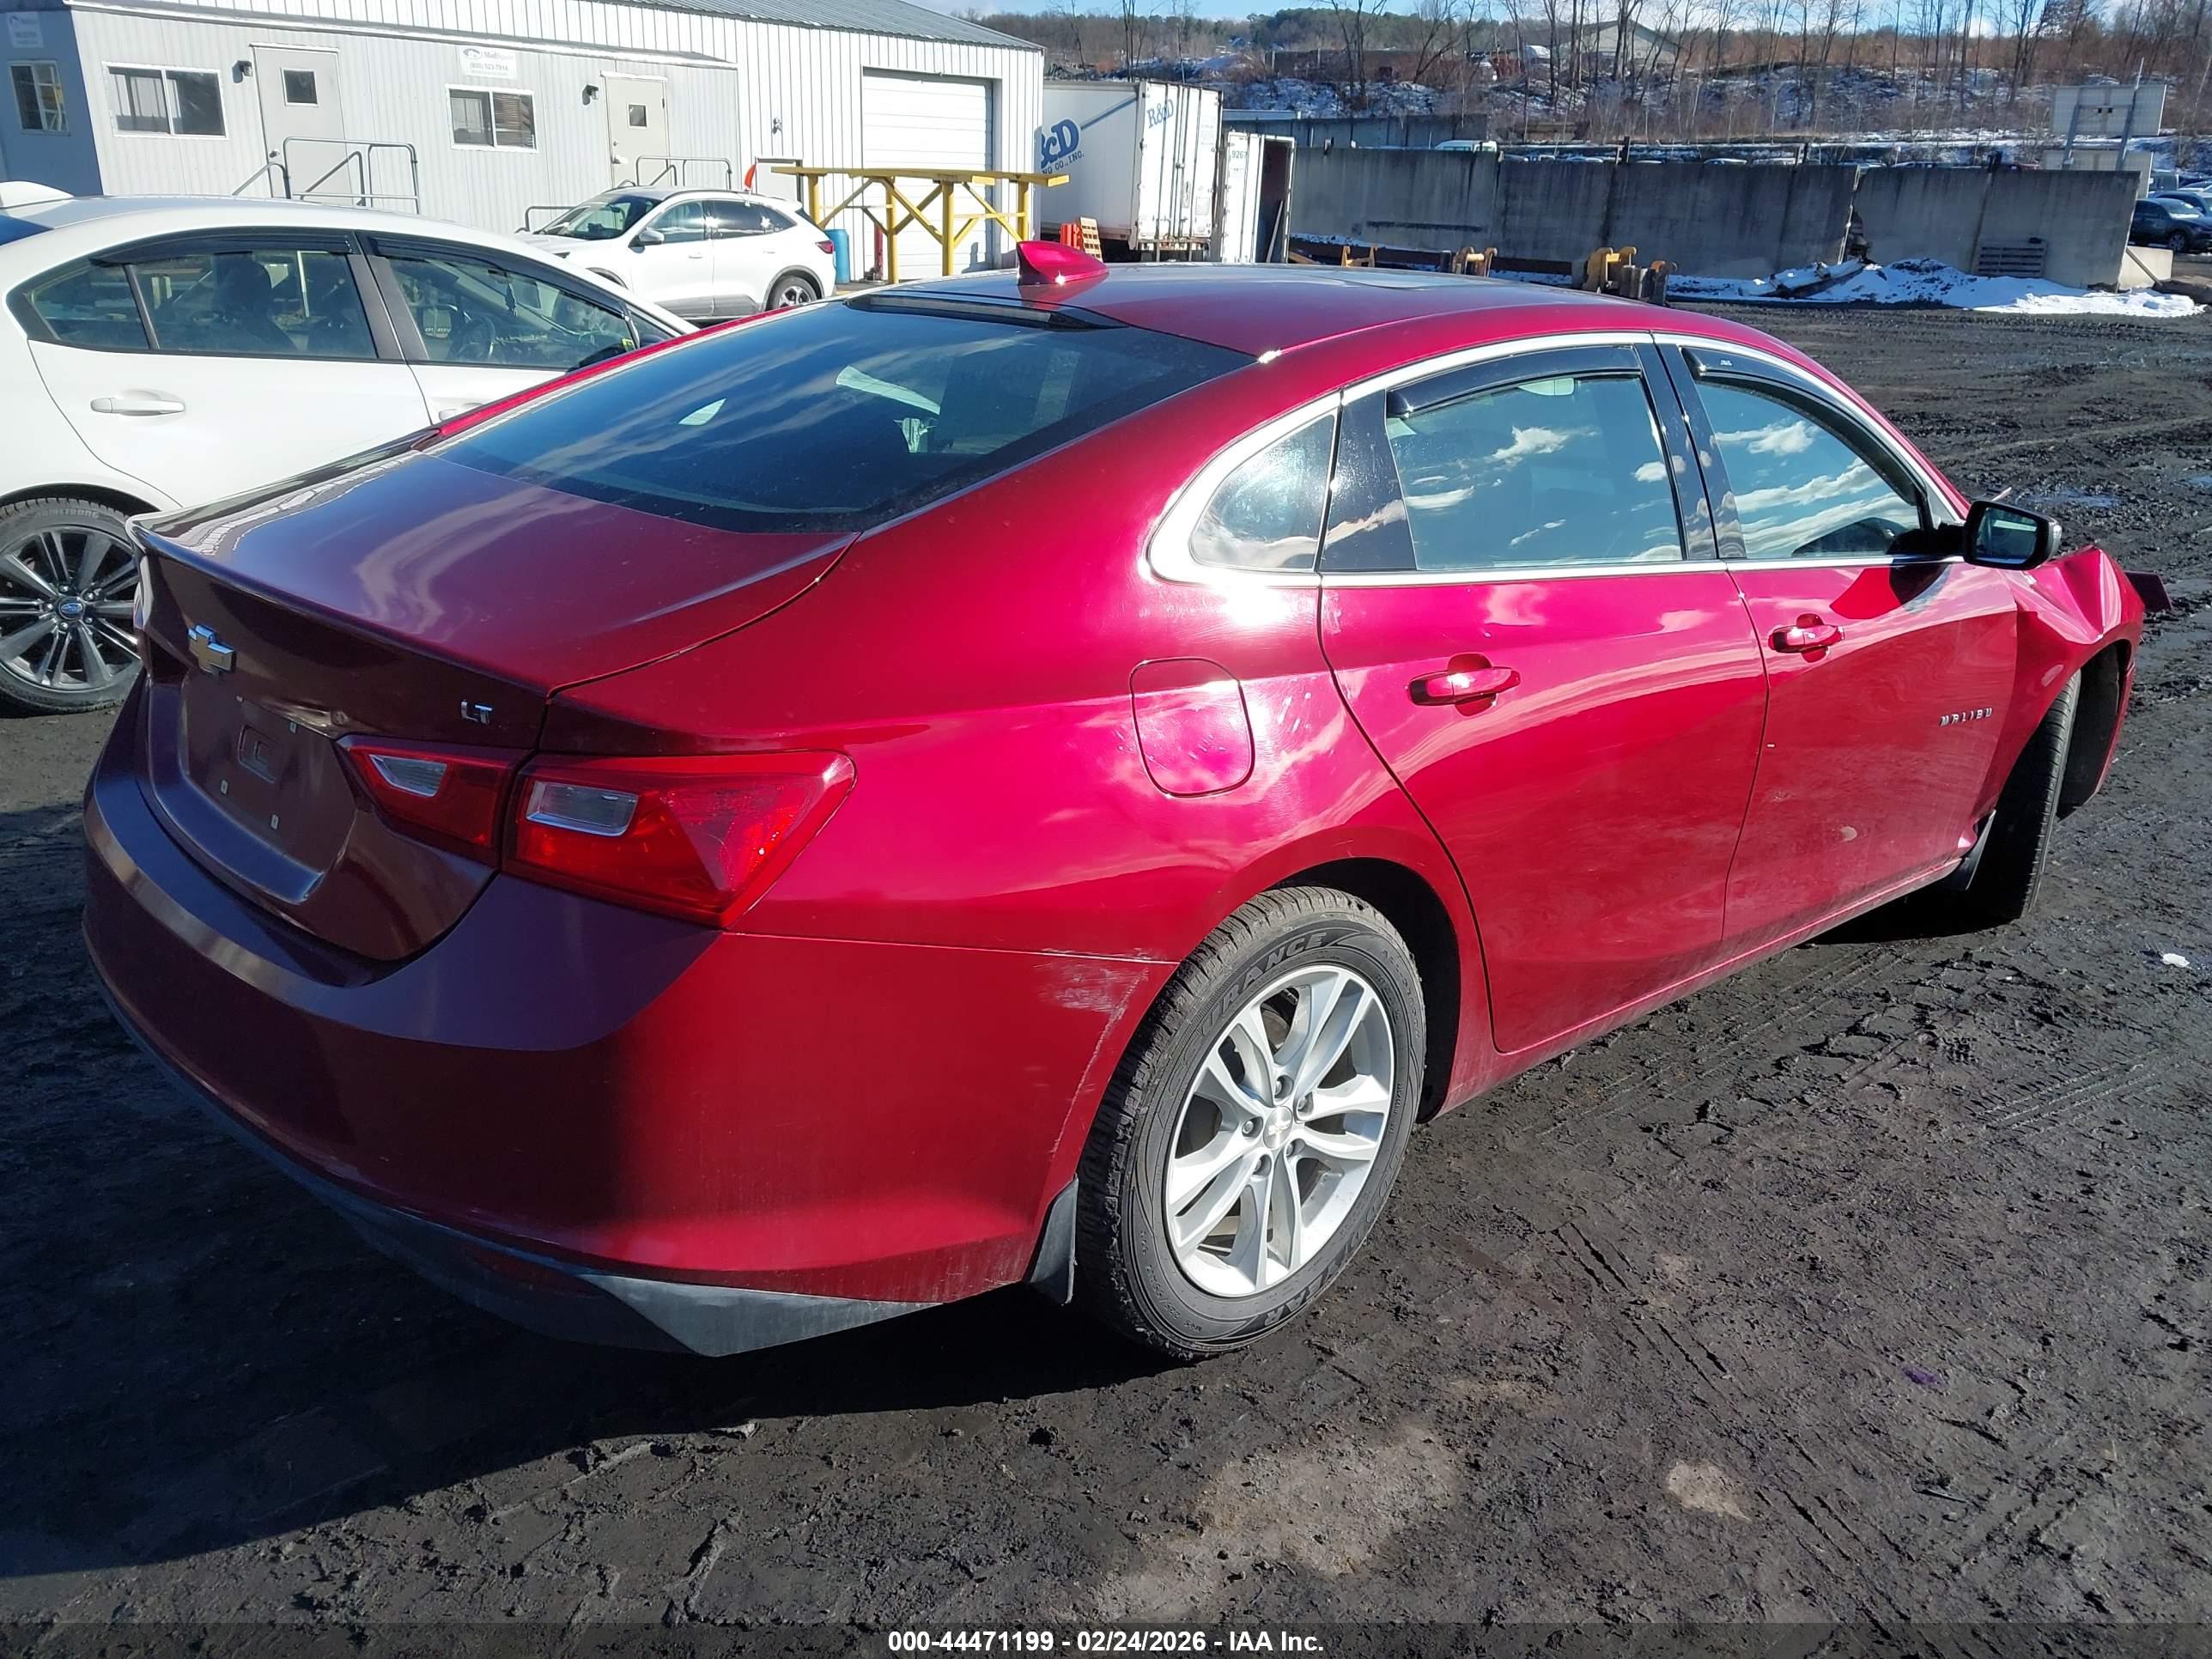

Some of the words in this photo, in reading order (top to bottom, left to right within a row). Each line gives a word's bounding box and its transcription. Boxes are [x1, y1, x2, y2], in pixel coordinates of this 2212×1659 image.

[1146, 98, 1174, 129] R&D
[460, 700, 493, 725] LT
[1939, 707, 1992, 727] MALIBU
